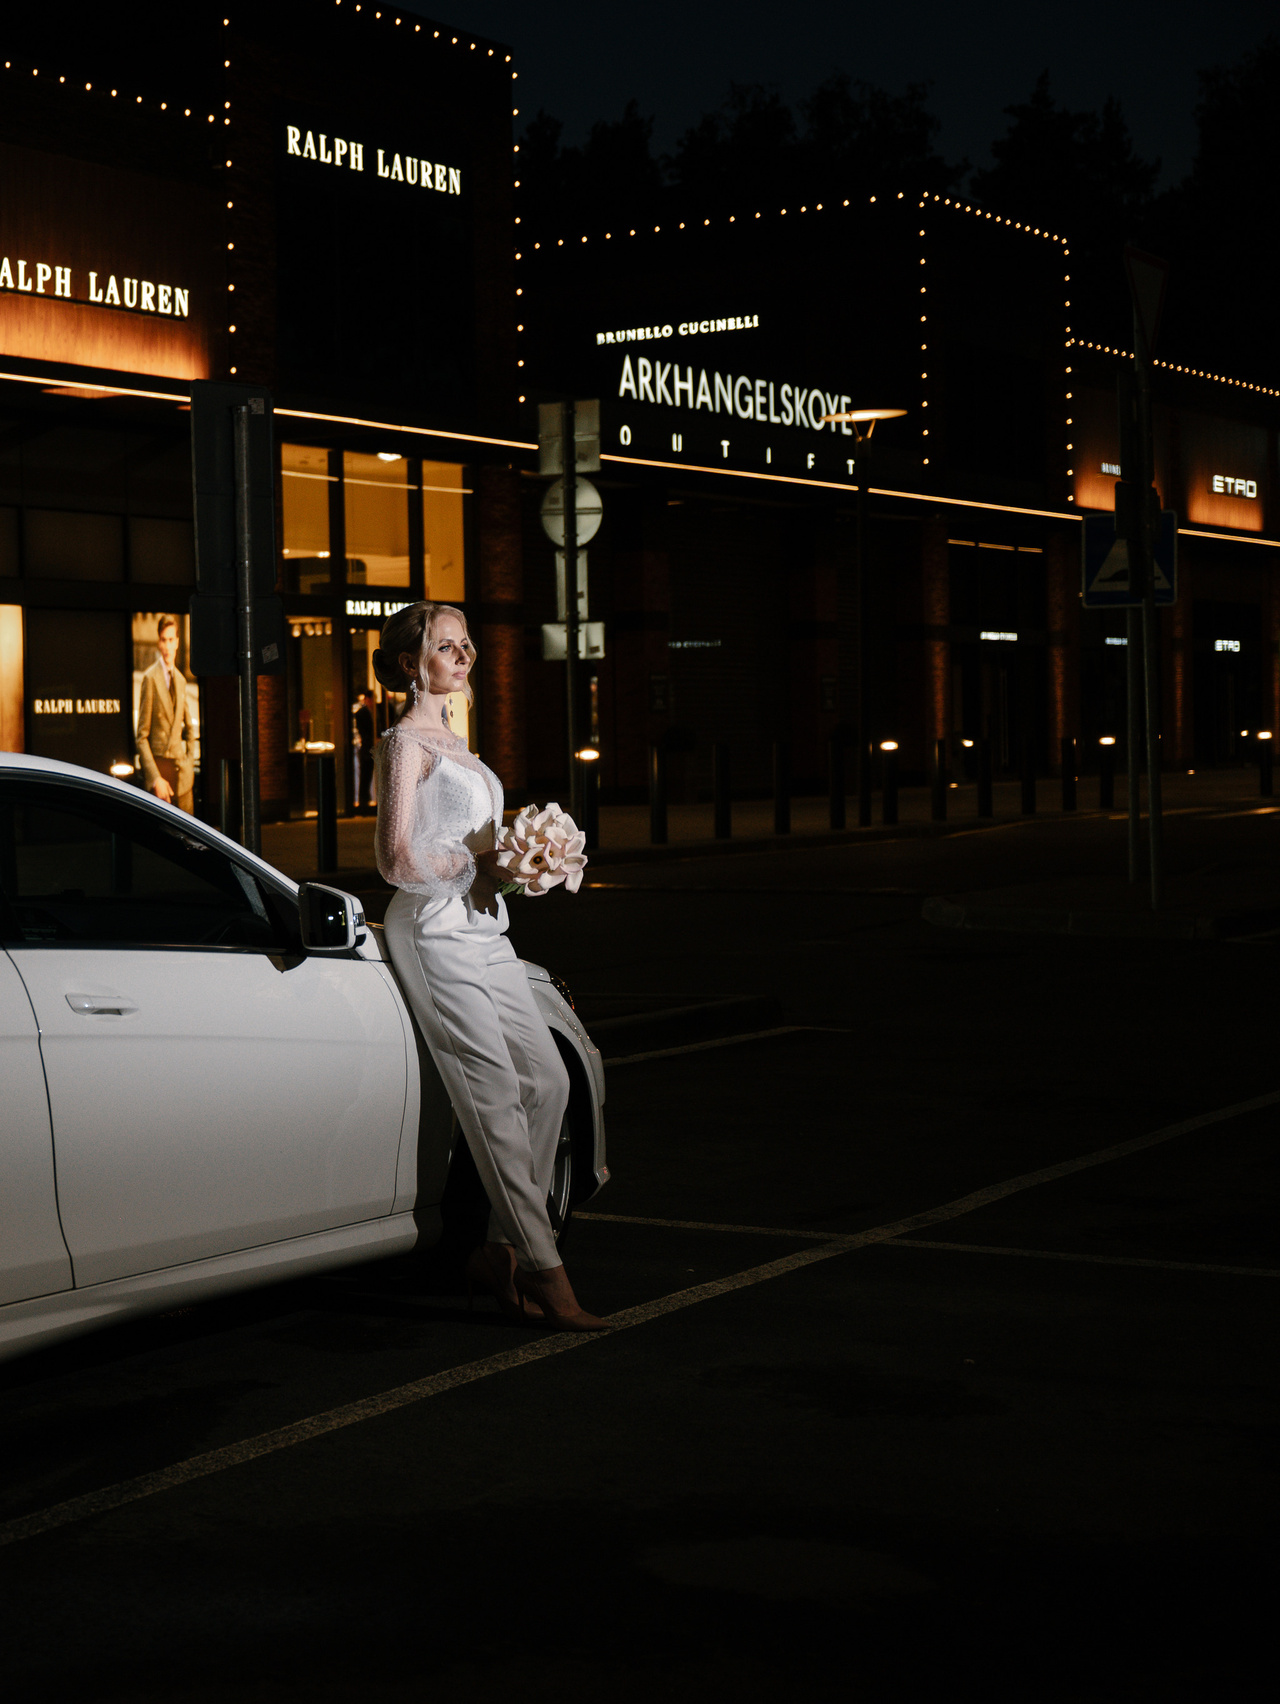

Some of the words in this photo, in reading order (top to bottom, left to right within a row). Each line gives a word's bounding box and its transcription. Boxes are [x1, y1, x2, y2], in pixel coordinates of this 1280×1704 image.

[286, 125, 365, 172] RALPH
[376, 148, 462, 196] LAUREN
[88, 271, 190, 318] LAUREN
[596, 324, 674, 345] BRUNELLO
[678, 314, 760, 336] CUCINELLI
[619, 353, 855, 436] ARKHANGELSKOYE
[346, 600, 381, 616] RALPH
[34, 698, 73, 714] RALPH
[76, 698, 121, 714] LAUREN
